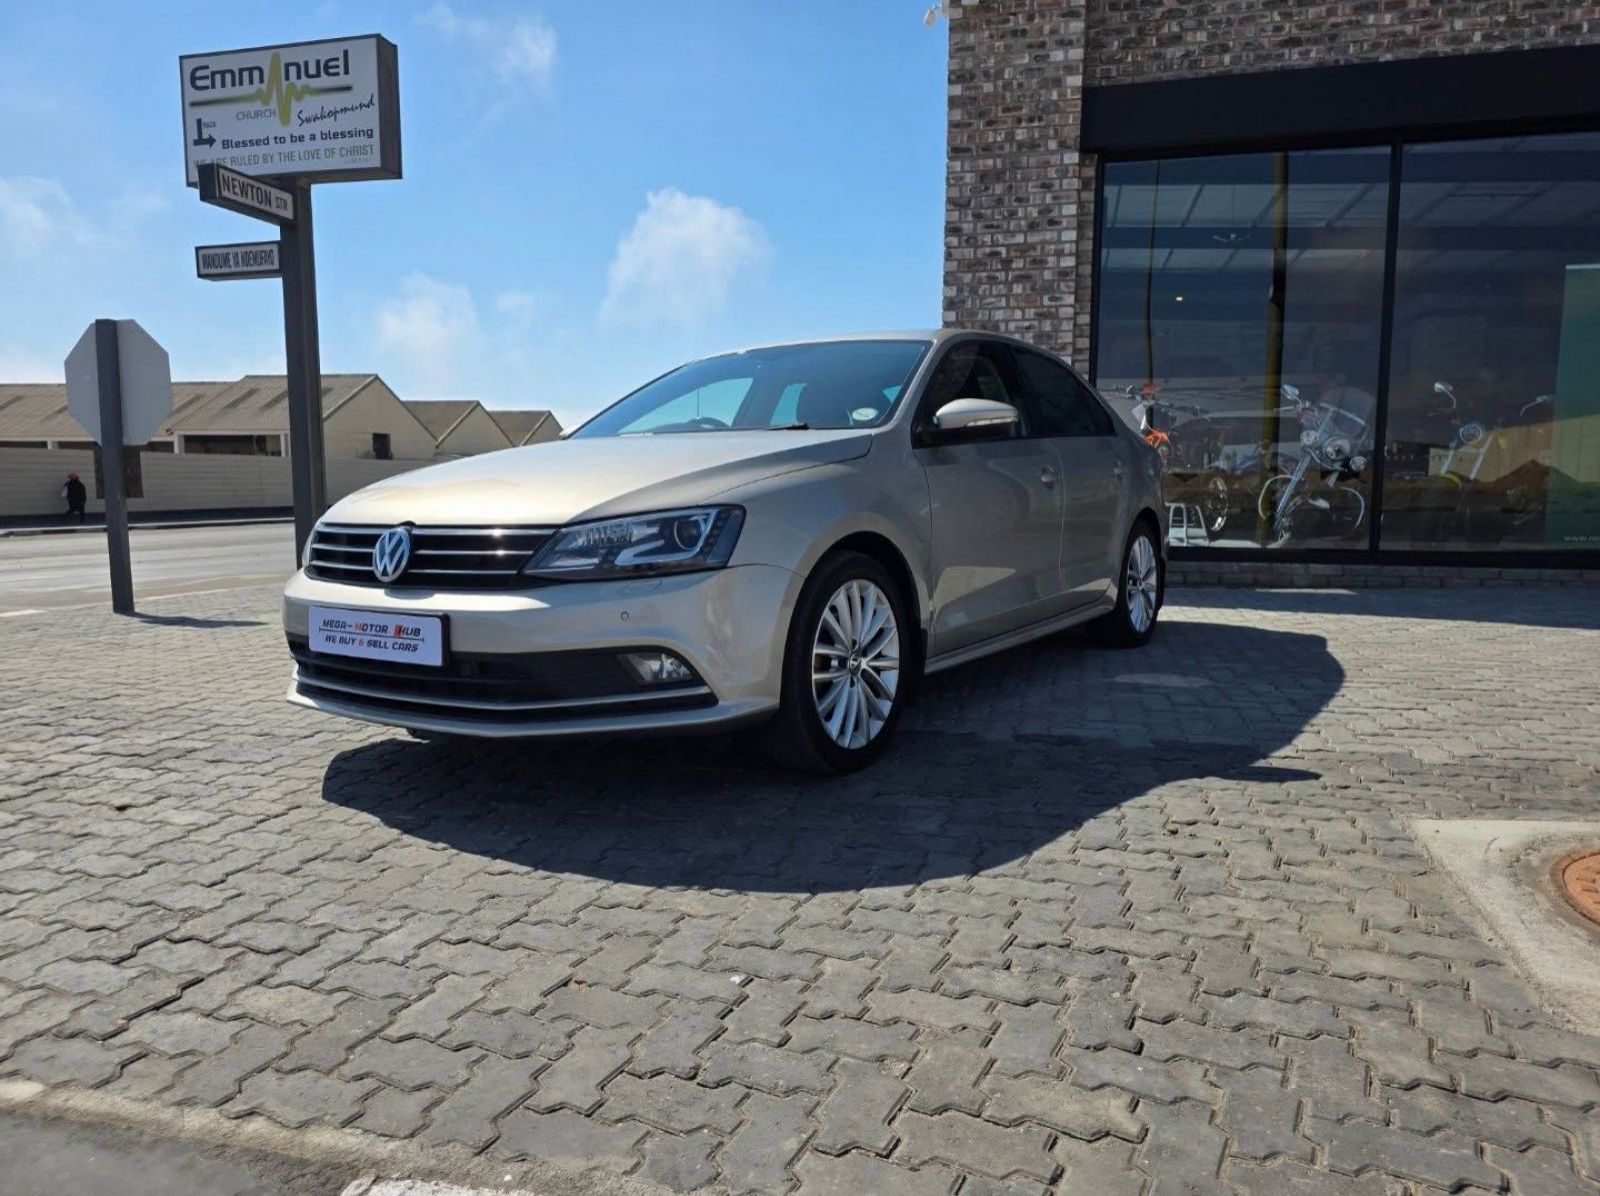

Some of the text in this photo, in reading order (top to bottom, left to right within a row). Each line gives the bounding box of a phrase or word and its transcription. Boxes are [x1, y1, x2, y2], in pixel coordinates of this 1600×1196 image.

[236, 107, 277, 121] CHURCH
[221, 127, 374, 149] Blessed to be a blessing
[230, 154, 260, 167] RULED
[262, 152, 274, 164] BY
[277, 150, 296, 163] THE
[298, 148, 321, 161] LOVE
[324, 147, 337, 159] OF
[340, 144, 376, 158] CHRIST
[221, 173, 272, 209] NEWTON
[354, 622, 389, 634] MOTOR
[397, 624, 422, 637] HUB
[325, 633, 338, 644] WE
[338, 635, 357, 646] BUY
[366, 638, 389, 650] SELL
[391, 640, 420, 652] CARS
